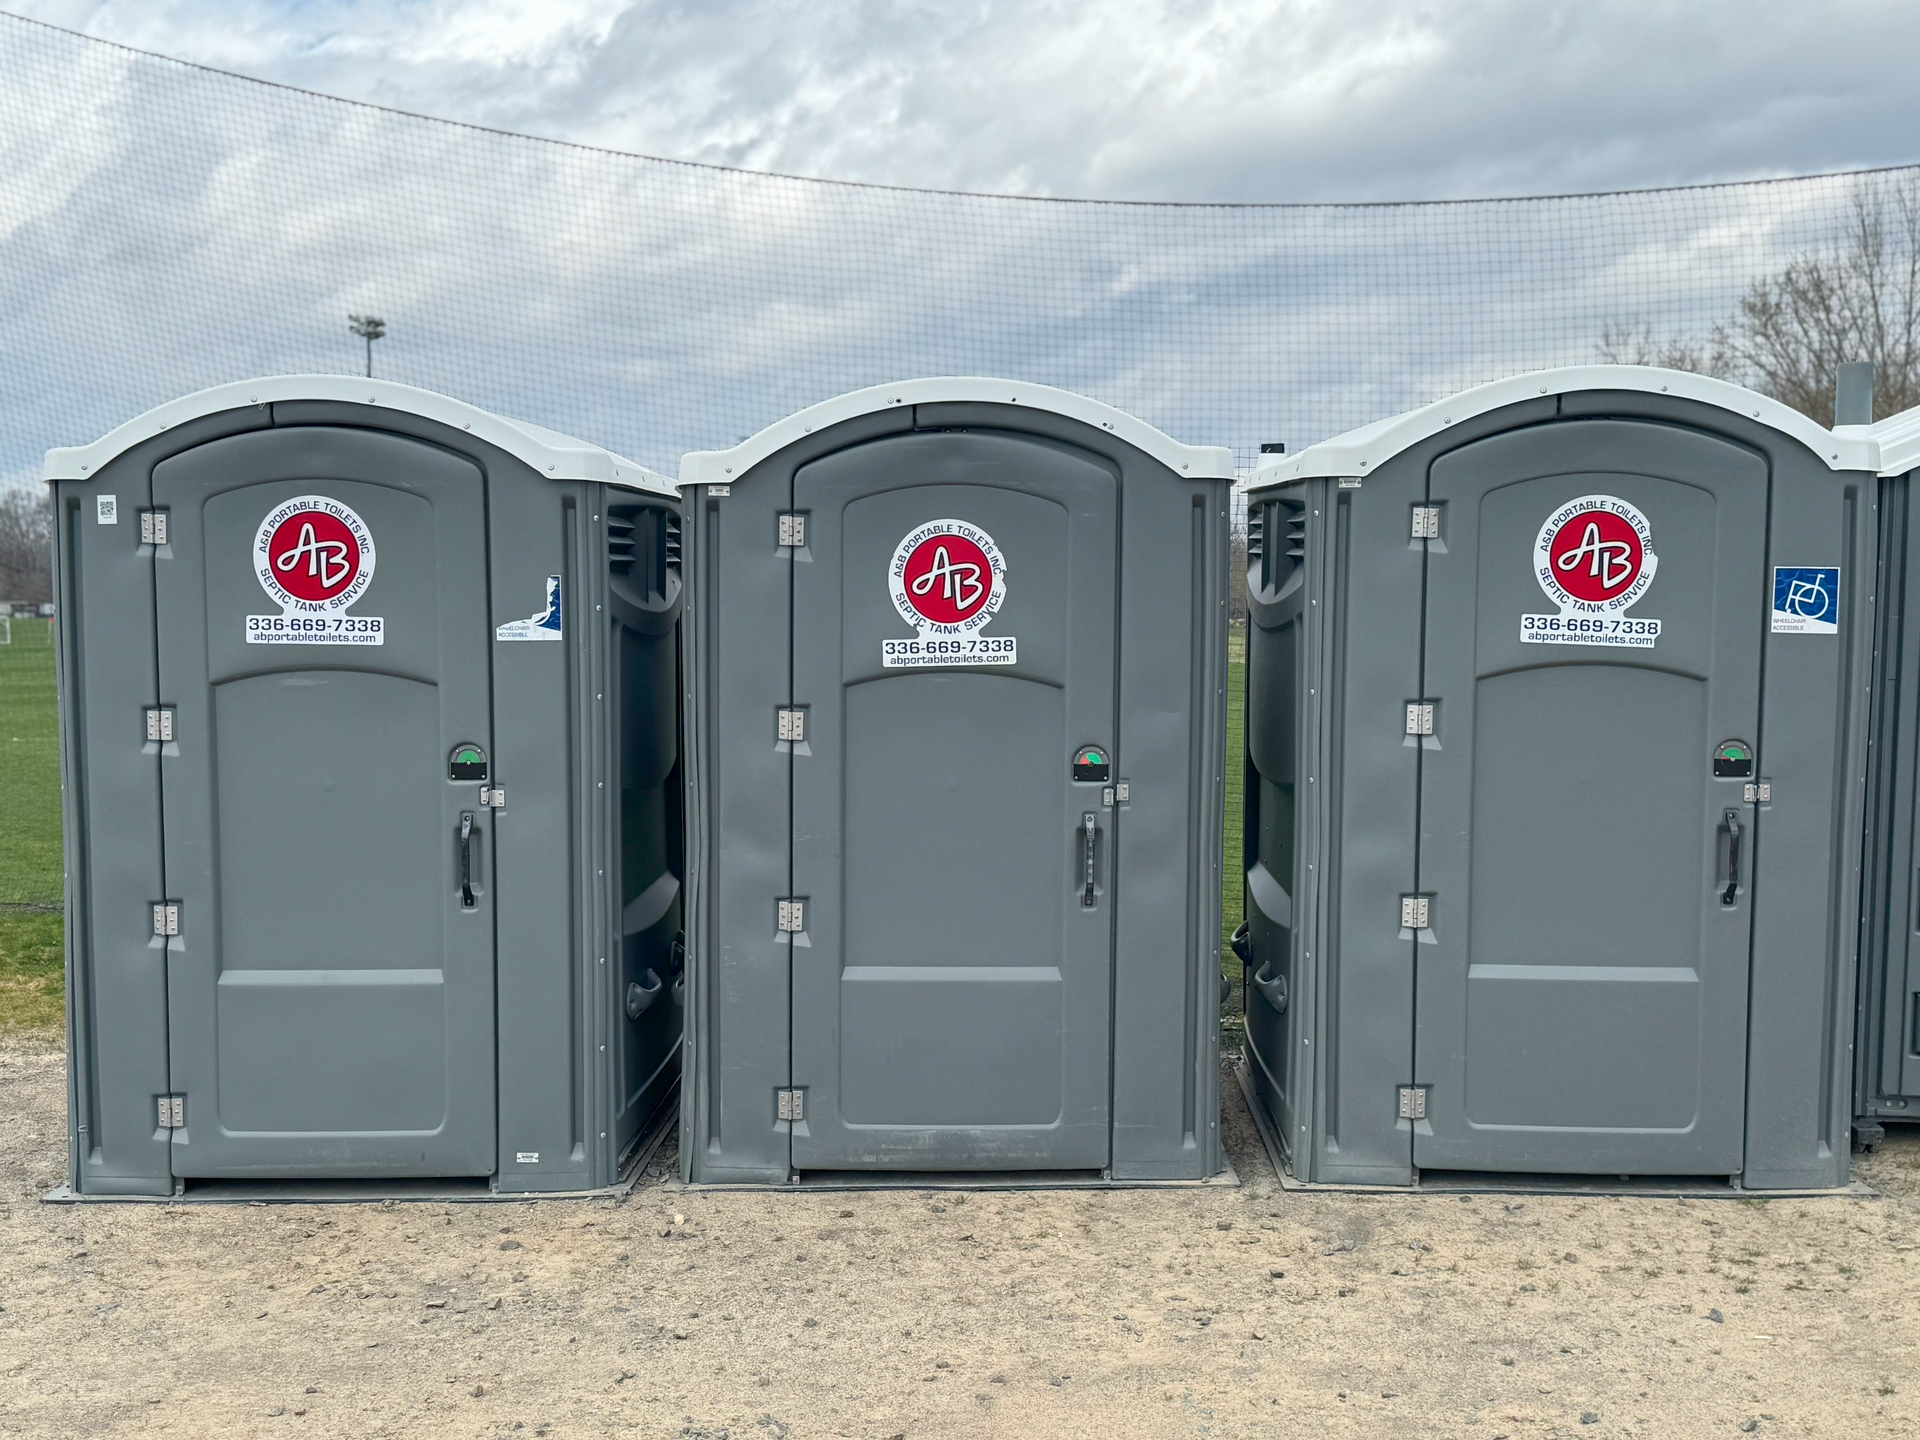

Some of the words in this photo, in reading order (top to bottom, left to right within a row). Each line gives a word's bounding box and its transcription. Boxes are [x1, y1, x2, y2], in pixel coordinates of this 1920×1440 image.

[259, 529, 272, 553] A&B
[268, 500, 320, 529] PORTABLE
[324, 502, 362, 534] TOILETS
[357, 534, 370, 557] INC.
[1540, 528, 1555, 552] A&B
[1552, 500, 1607, 528] PORTABLE
[1610, 502, 1647, 534] TOILETS
[894, 554, 907, 578] A&B
[903, 524, 953, 554] PORTABLE
[957, 525, 994, 555] TOILETS
[260, 568, 291, 604] SEPTIC
[294, 599, 327, 612] TANK
[329, 569, 369, 609] SERVICE
[1539, 567, 1570, 604] SEPTIC
[1572, 599, 1606, 613] TANK
[1608, 570, 1650, 610] SERVICE
[249, 618, 381, 632] 336-669-7338
[929, 622, 961, 634] TANK
[1523, 617, 1659, 634] 336-669-7338
[253, 632, 376, 643] abportabletoilets.com
[1528, 631, 1653, 645] abportabletoilets.com
[885, 639, 1014, 654] 336-669-7338
[890, 654, 1009, 666] abportabletoilets.com
